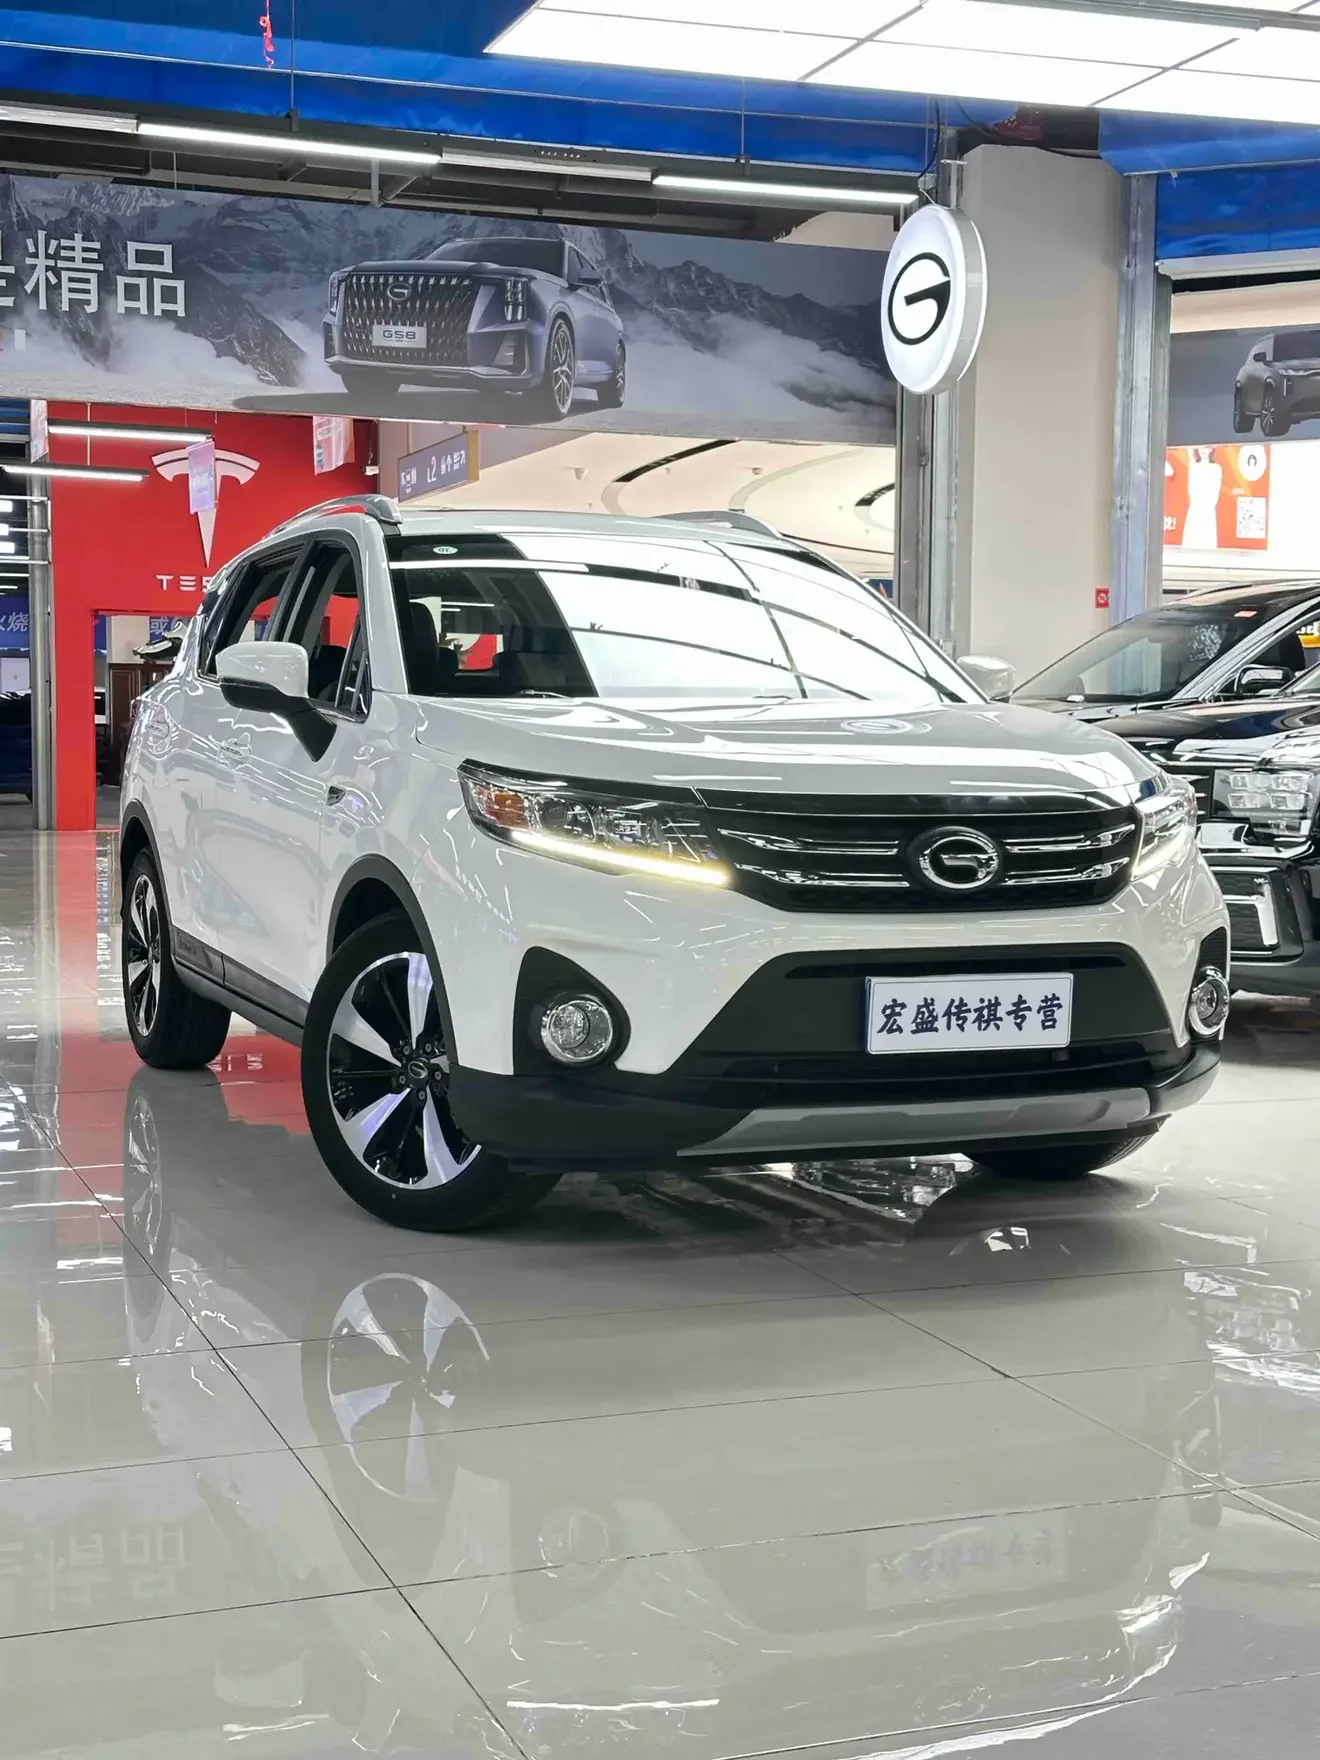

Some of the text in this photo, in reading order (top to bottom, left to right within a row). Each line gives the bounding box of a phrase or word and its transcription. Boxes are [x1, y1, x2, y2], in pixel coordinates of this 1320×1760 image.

[0, 229, 186, 317] 精品
[877, 993, 1063, 1034] 宏盛传祺专营
